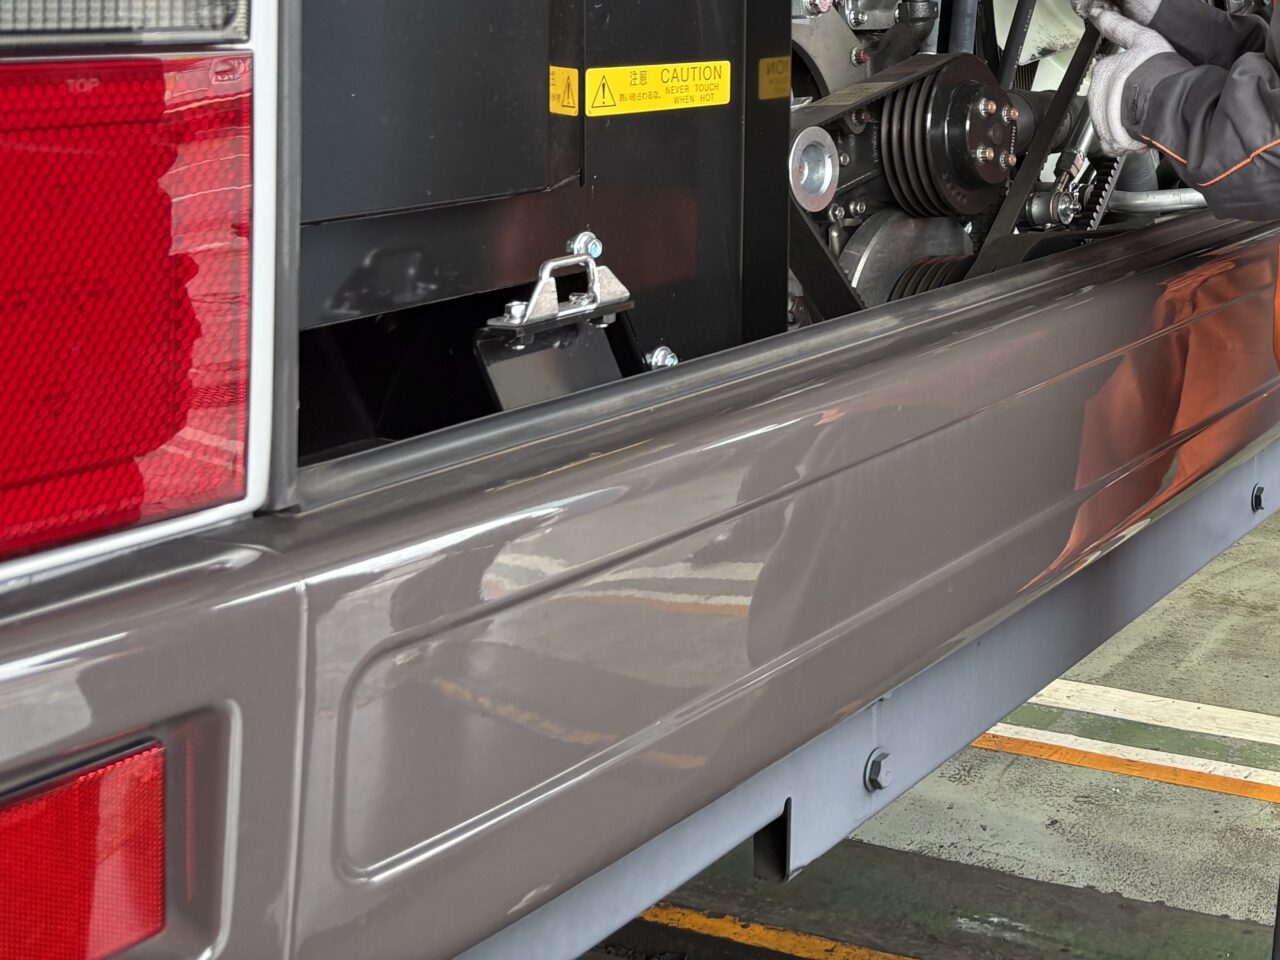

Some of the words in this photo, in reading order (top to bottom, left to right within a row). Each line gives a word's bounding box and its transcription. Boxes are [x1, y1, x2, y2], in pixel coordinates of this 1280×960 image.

[629, 70, 648, 86] 注意
[660, 65, 722, 84] CAUTION
[66, 78, 99, 92] TOP
[665, 85, 689, 95] NEVER
[695, 82, 720, 93] TOUCH
[673, 95, 695, 104] WHEN
[700, 93, 714, 102] HOT
